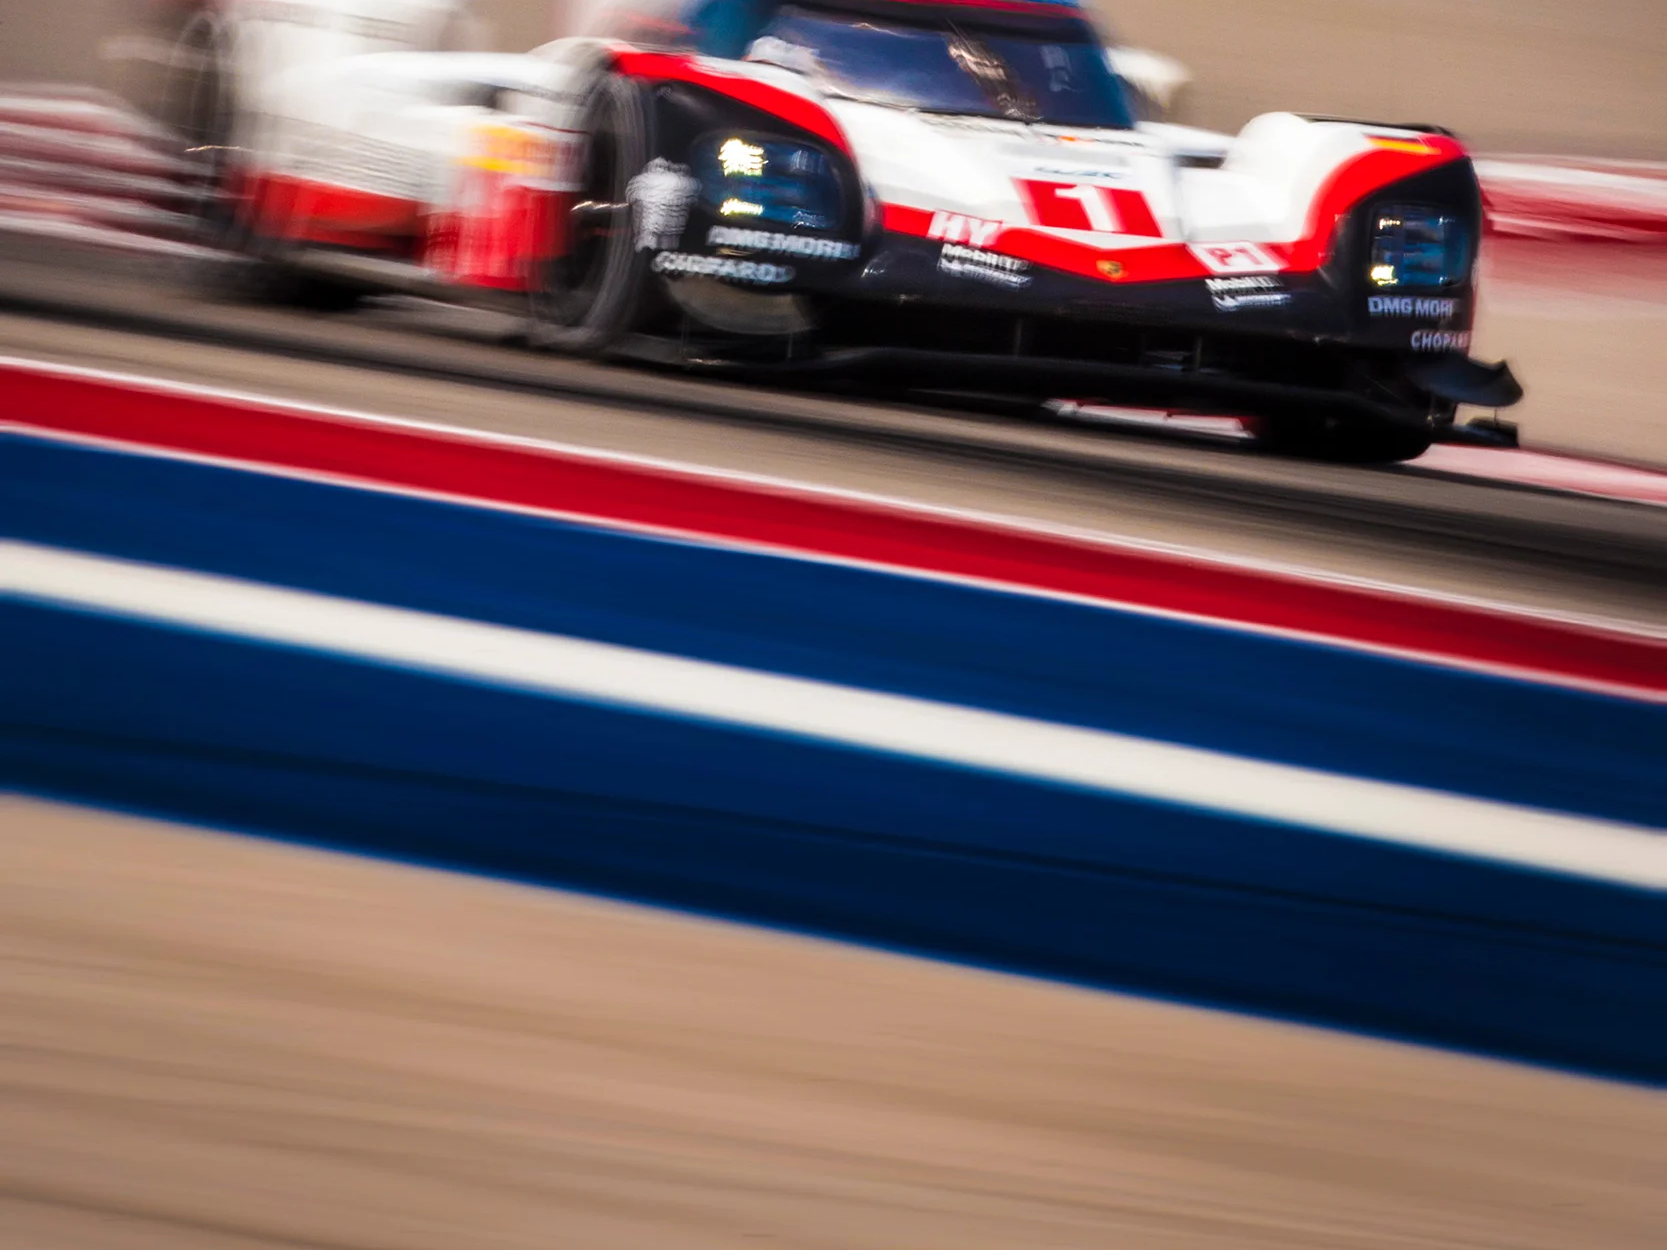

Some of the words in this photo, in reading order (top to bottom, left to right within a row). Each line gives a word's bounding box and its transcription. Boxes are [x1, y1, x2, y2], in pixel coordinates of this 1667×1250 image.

[1054, 184, 1117, 232] 1
[927, 211, 1002, 248] HY
[1204, 247, 1263, 266] P1
[1367, 297, 1412, 315] DMG
[1415, 299, 1454, 317] MORI
